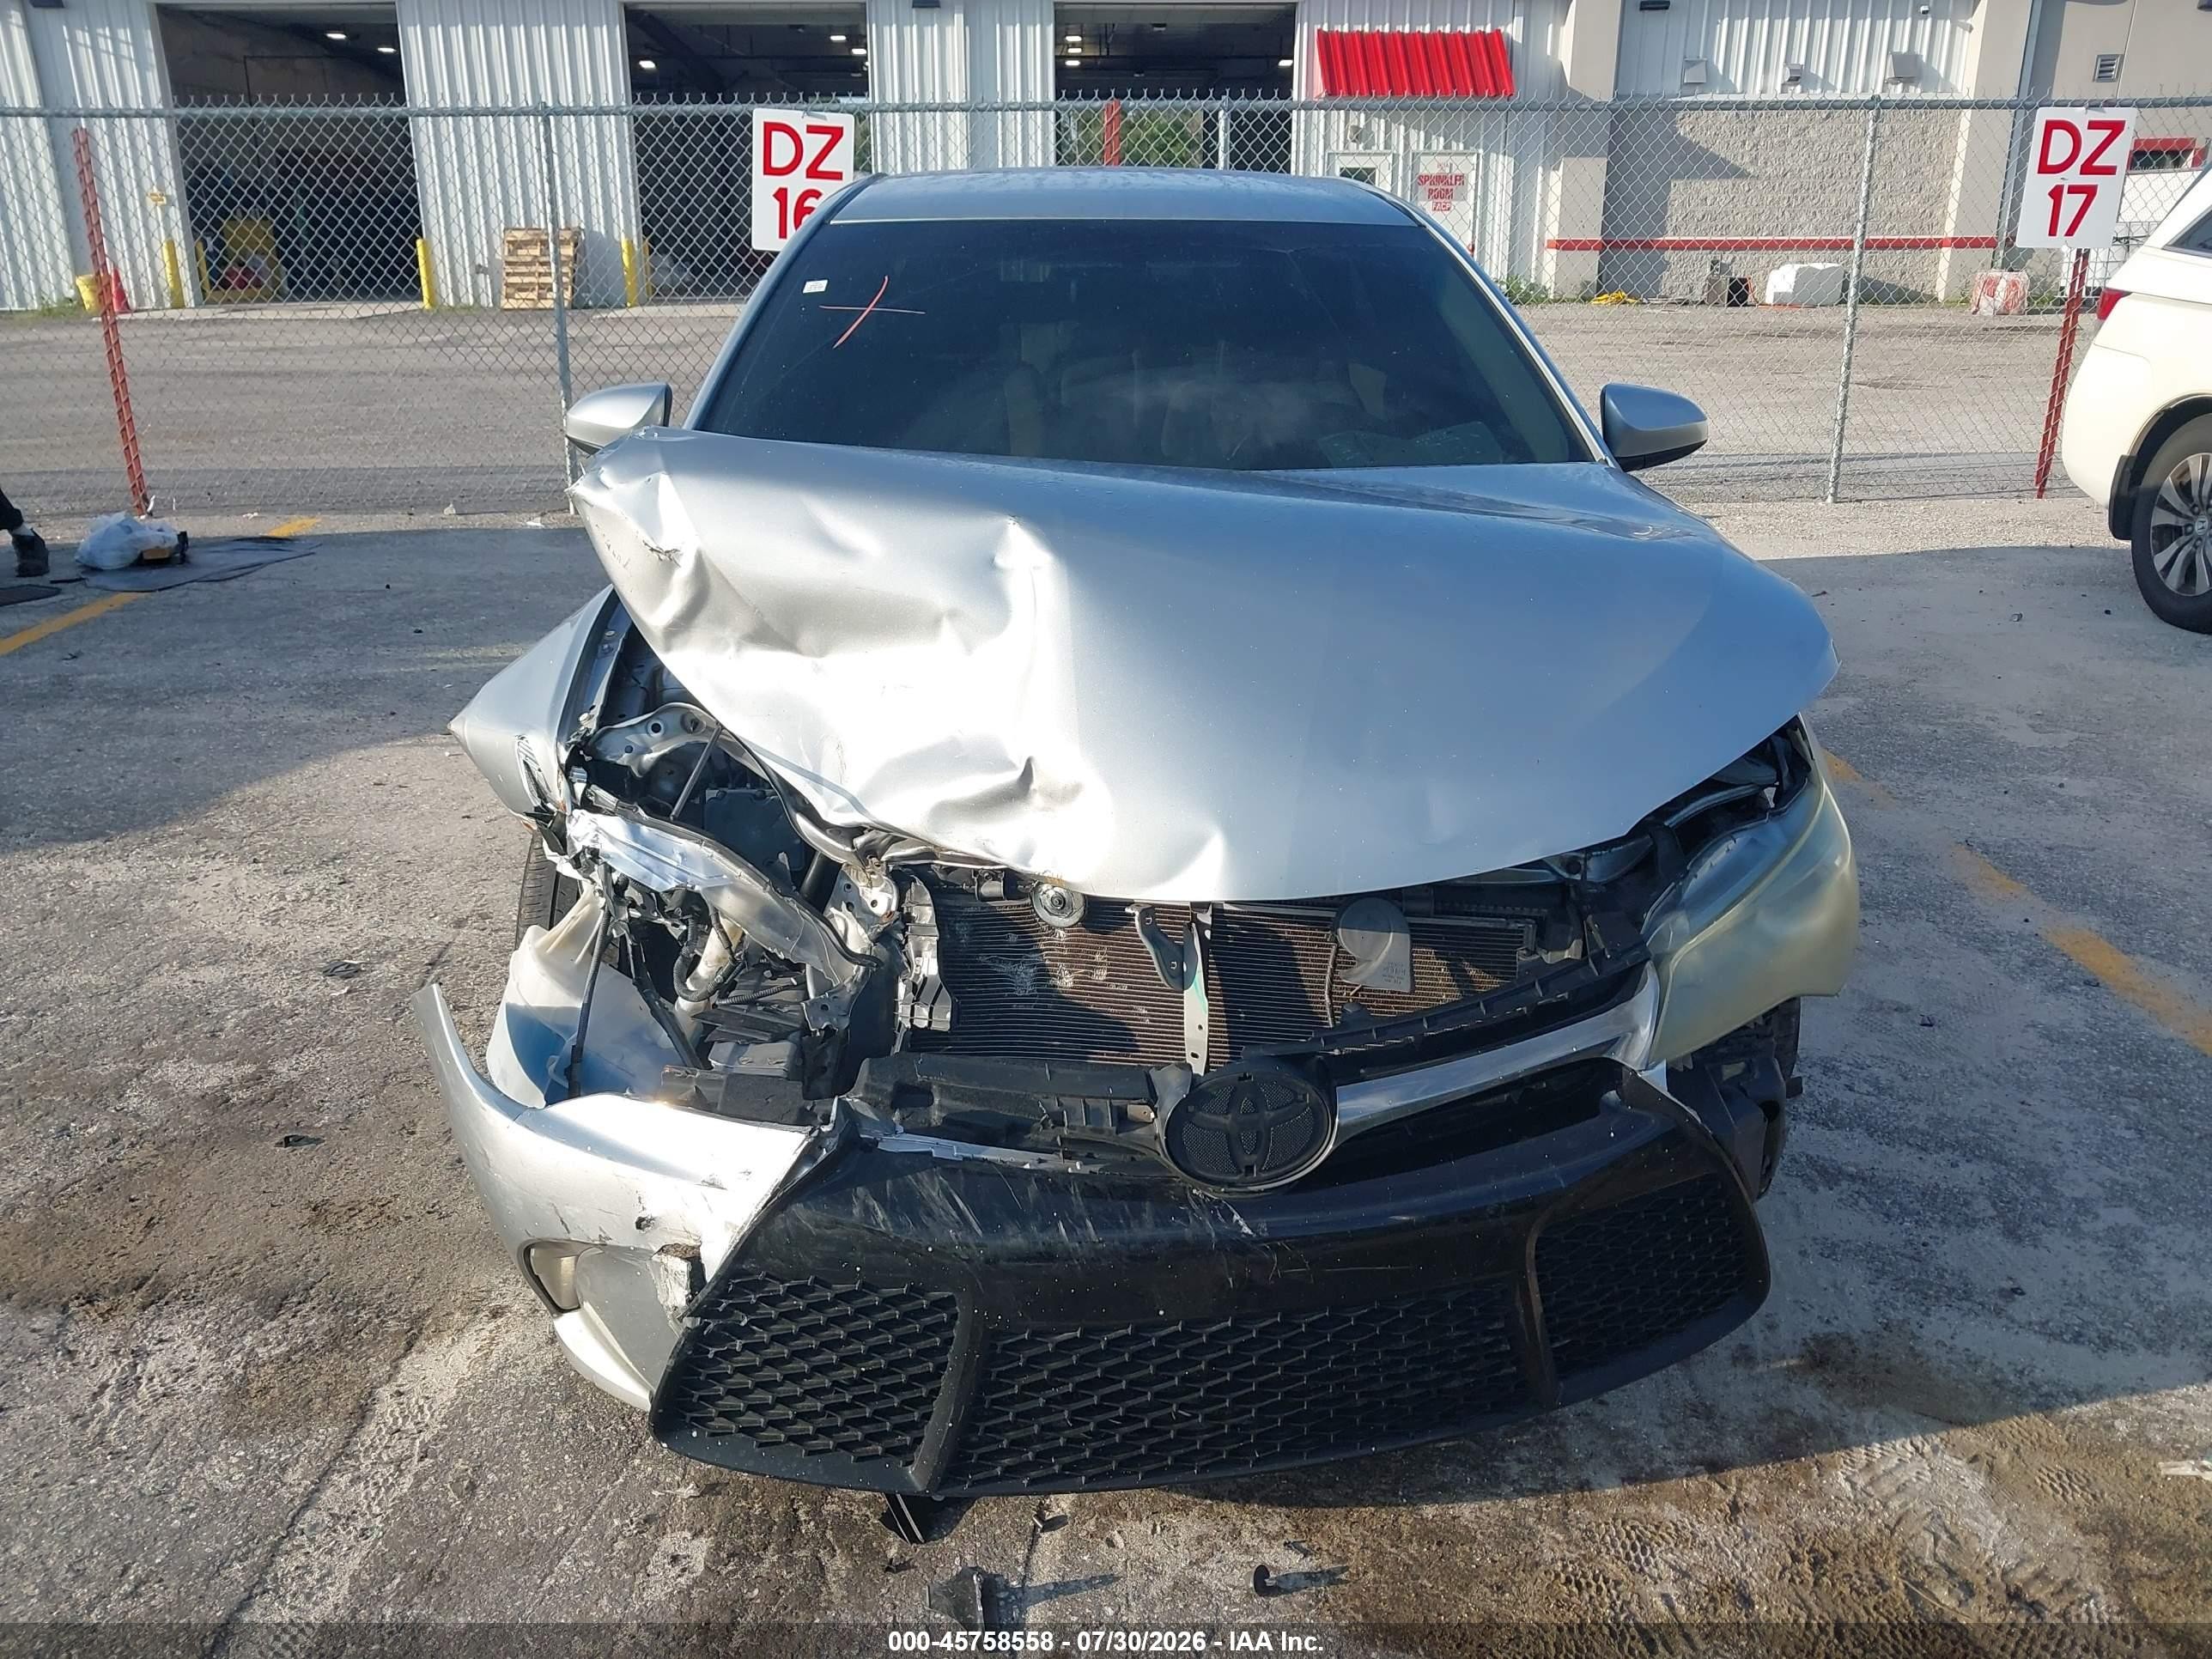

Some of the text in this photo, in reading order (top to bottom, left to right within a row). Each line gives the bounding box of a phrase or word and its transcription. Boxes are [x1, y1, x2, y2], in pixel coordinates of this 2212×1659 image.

[763, 121, 844, 180] DZ
[2037, 118, 2126, 175] DZ
[1427, 187, 1454, 200] ROOM
[2047, 184, 2099, 237] 17
